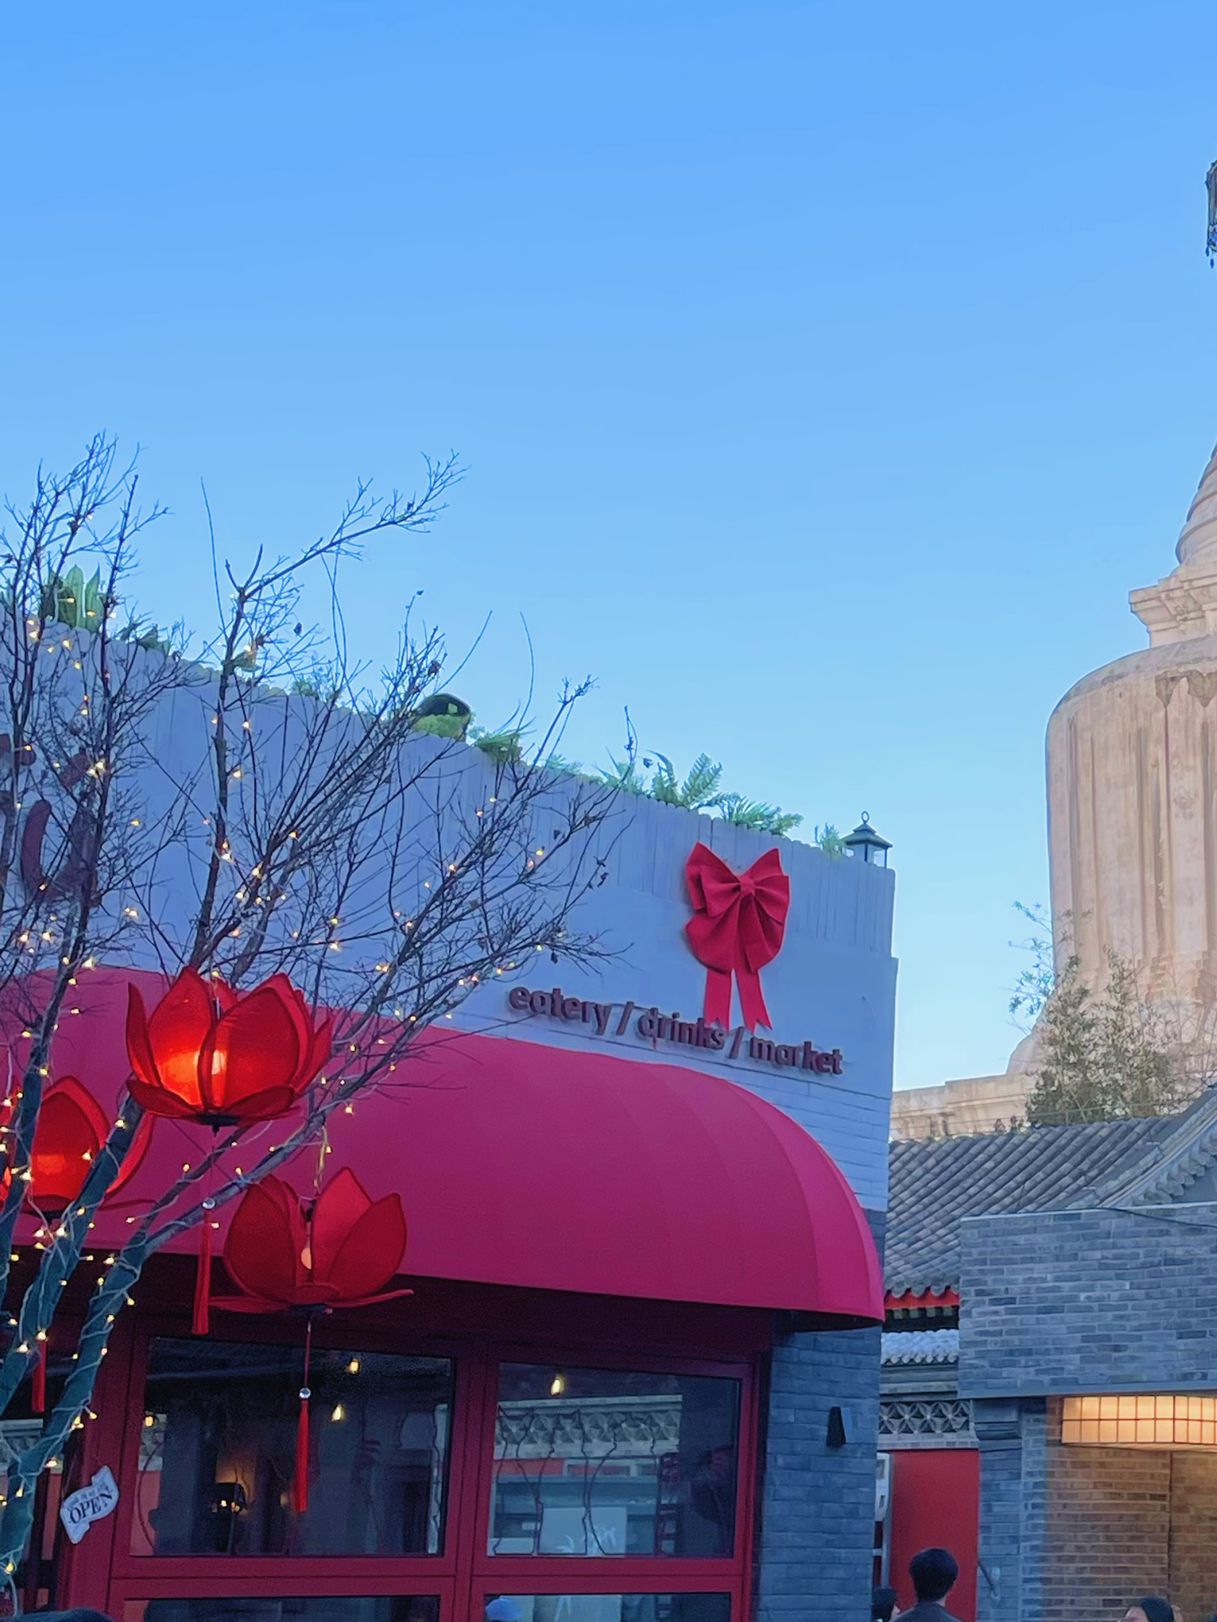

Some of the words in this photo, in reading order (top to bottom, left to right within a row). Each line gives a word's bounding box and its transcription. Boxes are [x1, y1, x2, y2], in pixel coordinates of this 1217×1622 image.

[508, 986, 611, 1036] eatery
[637, 1007, 725, 1050] drinks
[749, 1036, 843, 1075] market
[68, 1486, 113, 1524] OPEN
